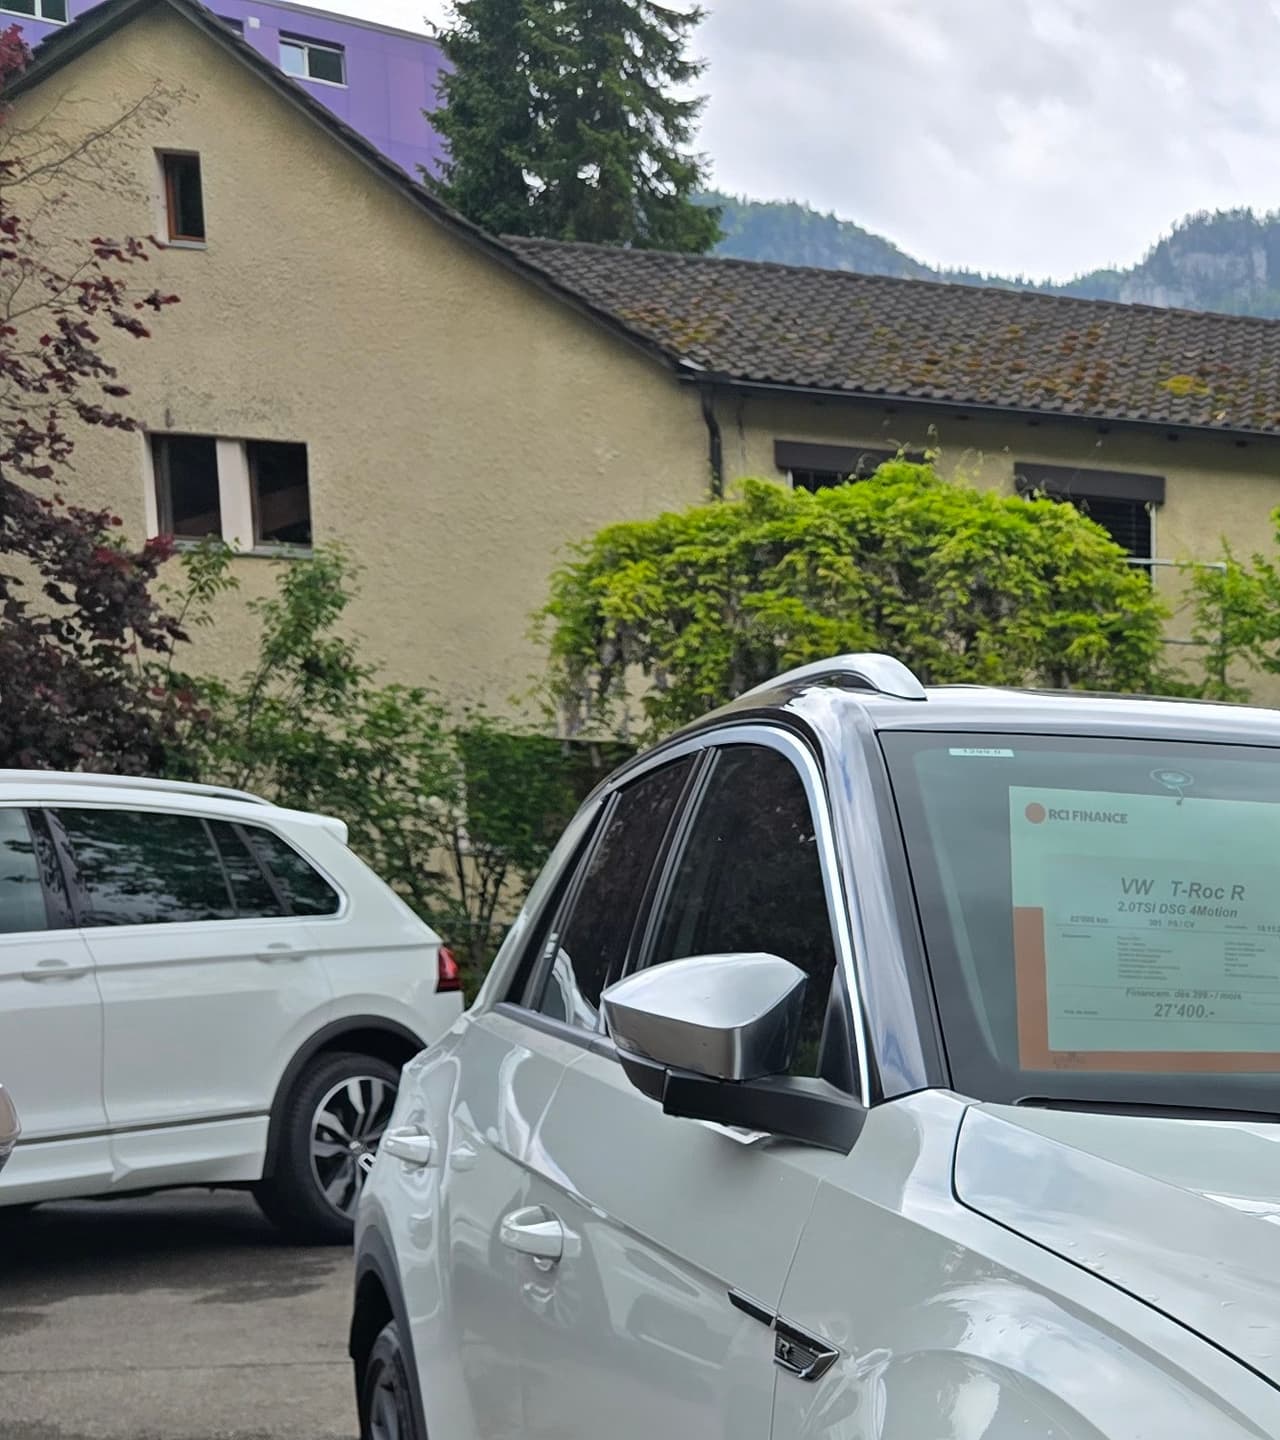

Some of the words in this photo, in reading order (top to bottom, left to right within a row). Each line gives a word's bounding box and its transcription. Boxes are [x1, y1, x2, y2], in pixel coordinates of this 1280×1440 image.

[1048, 808, 1070, 821] RCI
[1072, 809, 1129, 824] FINANCE
[1121, 877, 1154, 895] VW
[1170, 880, 1225, 900] T-Roc
[1230, 884, 1245, 901] R
[1117, 901, 1156, 913] 2.0TSI
[1158, 903, 1186, 915] DSG
[1189, 905, 1238, 918] 4Motion
[1154, 1003, 1215, 1019] 27'400.-
